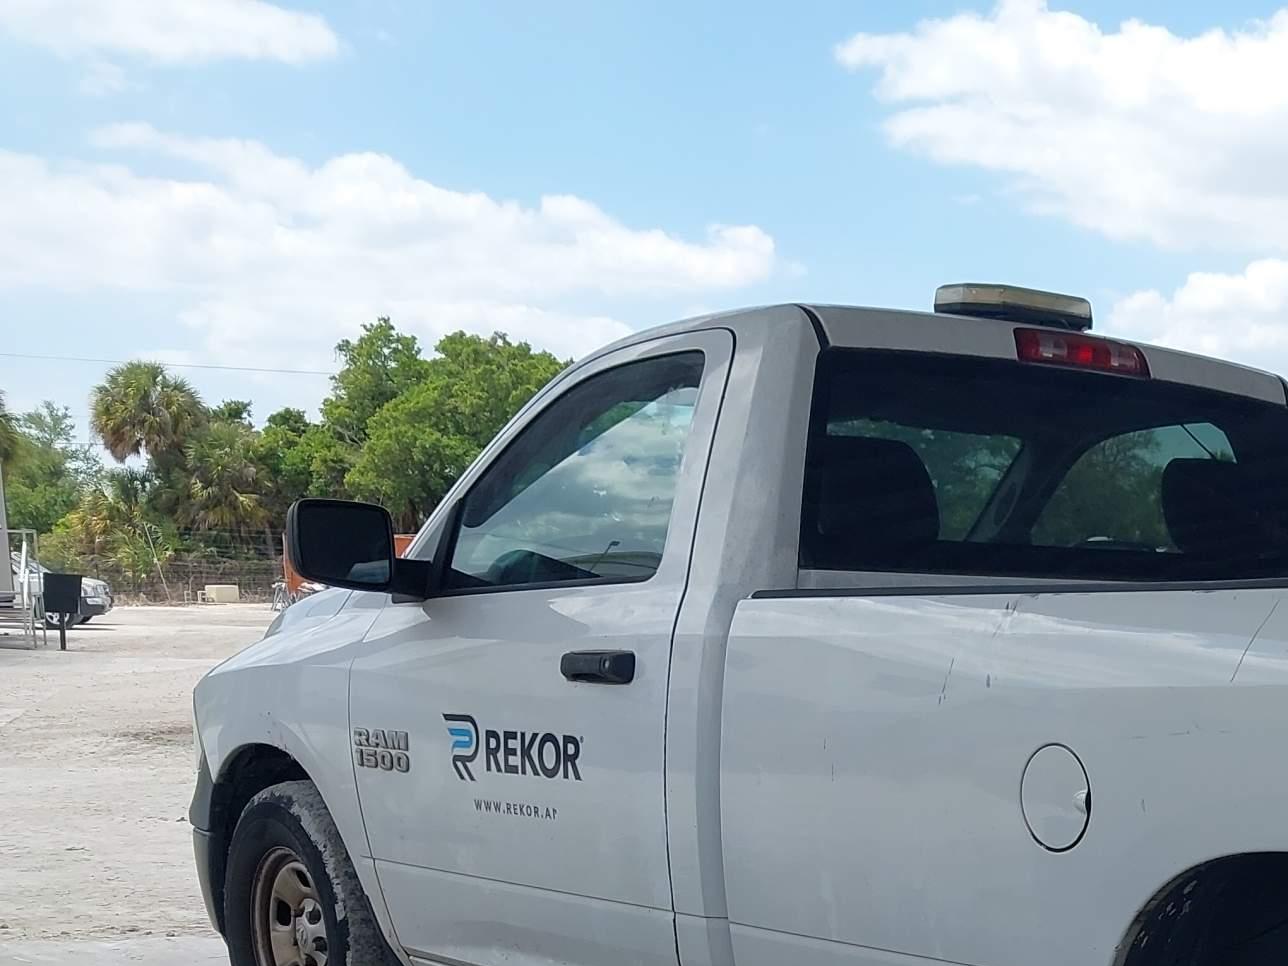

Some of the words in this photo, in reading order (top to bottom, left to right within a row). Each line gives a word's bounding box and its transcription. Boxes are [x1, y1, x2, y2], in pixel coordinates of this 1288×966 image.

[354, 727, 409, 751] RAM
[356, 747, 410, 773] 1500
[485, 729, 583, 781] REKOR
